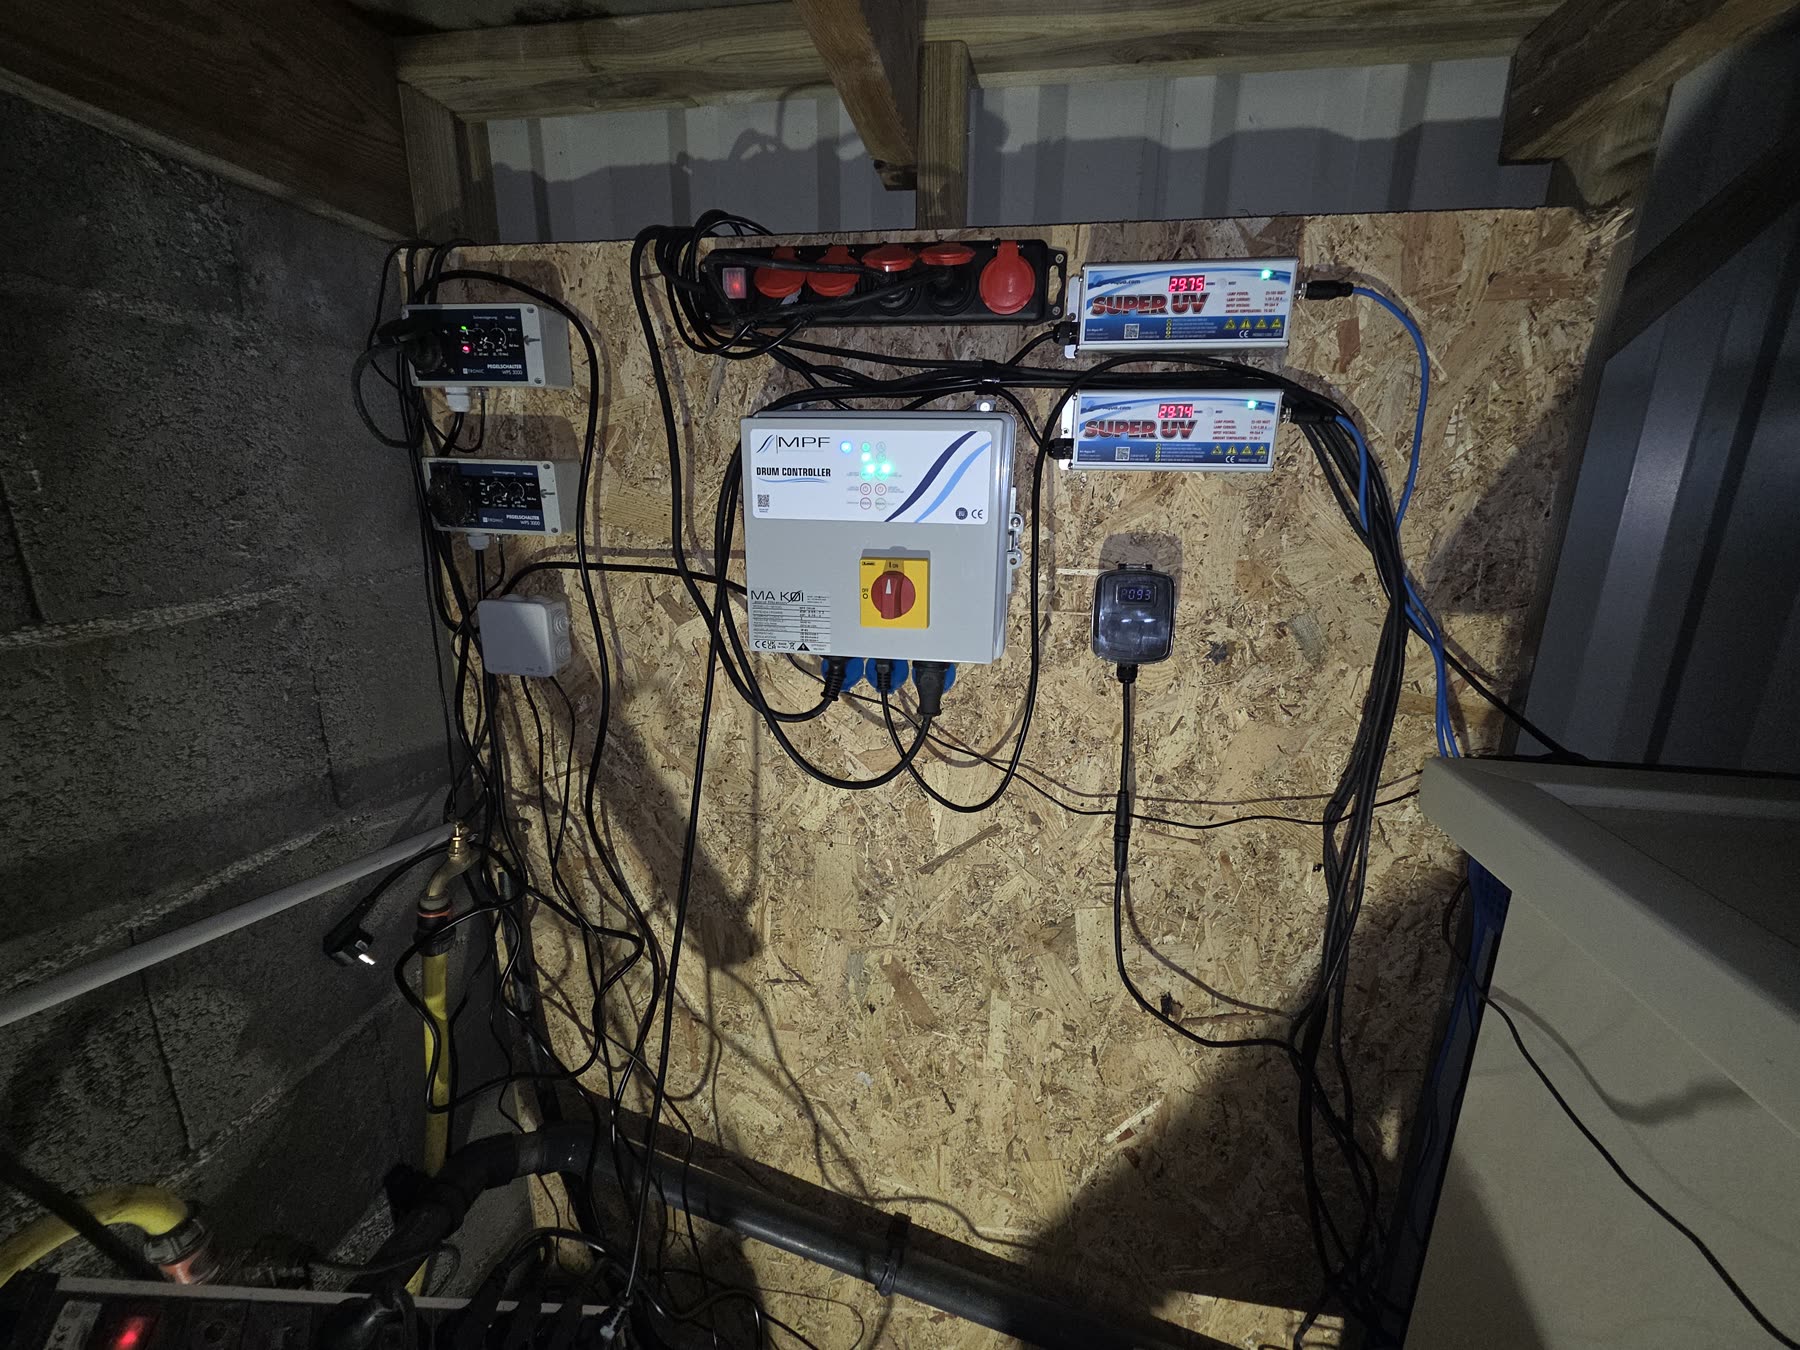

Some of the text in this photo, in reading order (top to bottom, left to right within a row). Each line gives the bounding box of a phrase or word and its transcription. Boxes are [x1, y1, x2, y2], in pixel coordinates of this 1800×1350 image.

[1091, 293, 1168, 316] SUPER
[1171, 293, 1210, 315] UV
[1083, 420, 1198, 439] SUPER UV
[778, 436, 831, 448] MPF
[756, 467, 831, 477] DRUM CONTROLLER
